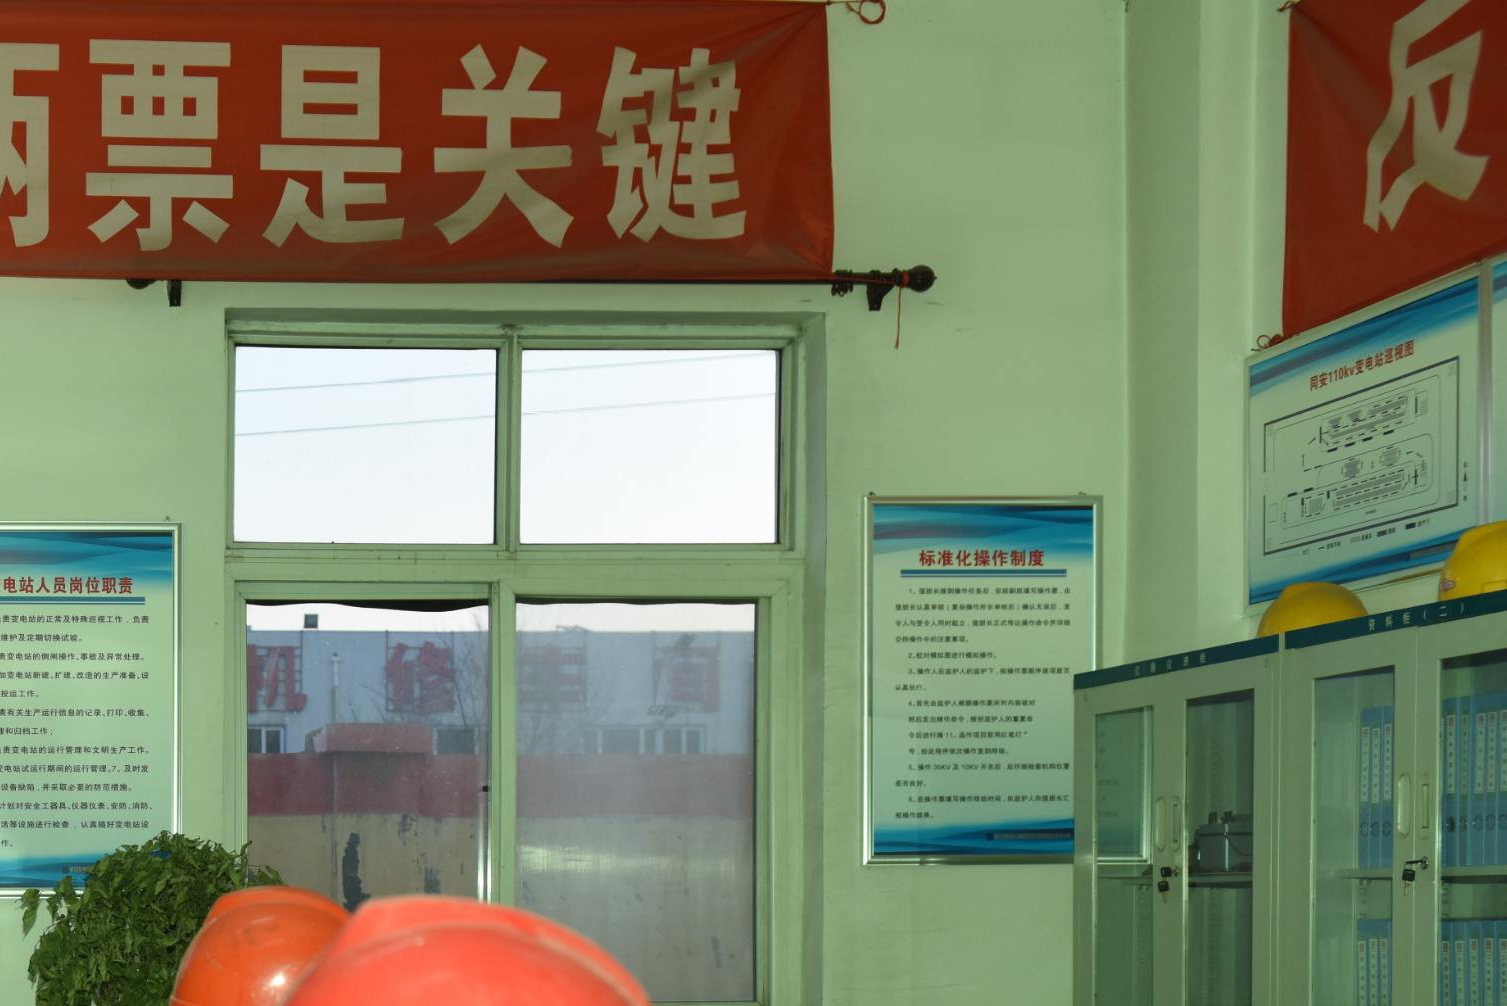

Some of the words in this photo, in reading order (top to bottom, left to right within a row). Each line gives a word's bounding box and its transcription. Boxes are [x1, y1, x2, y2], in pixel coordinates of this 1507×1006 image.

[1363, 0, 1490, 233] 反
[919, 549, 1045, 567] 标准化操作制度
